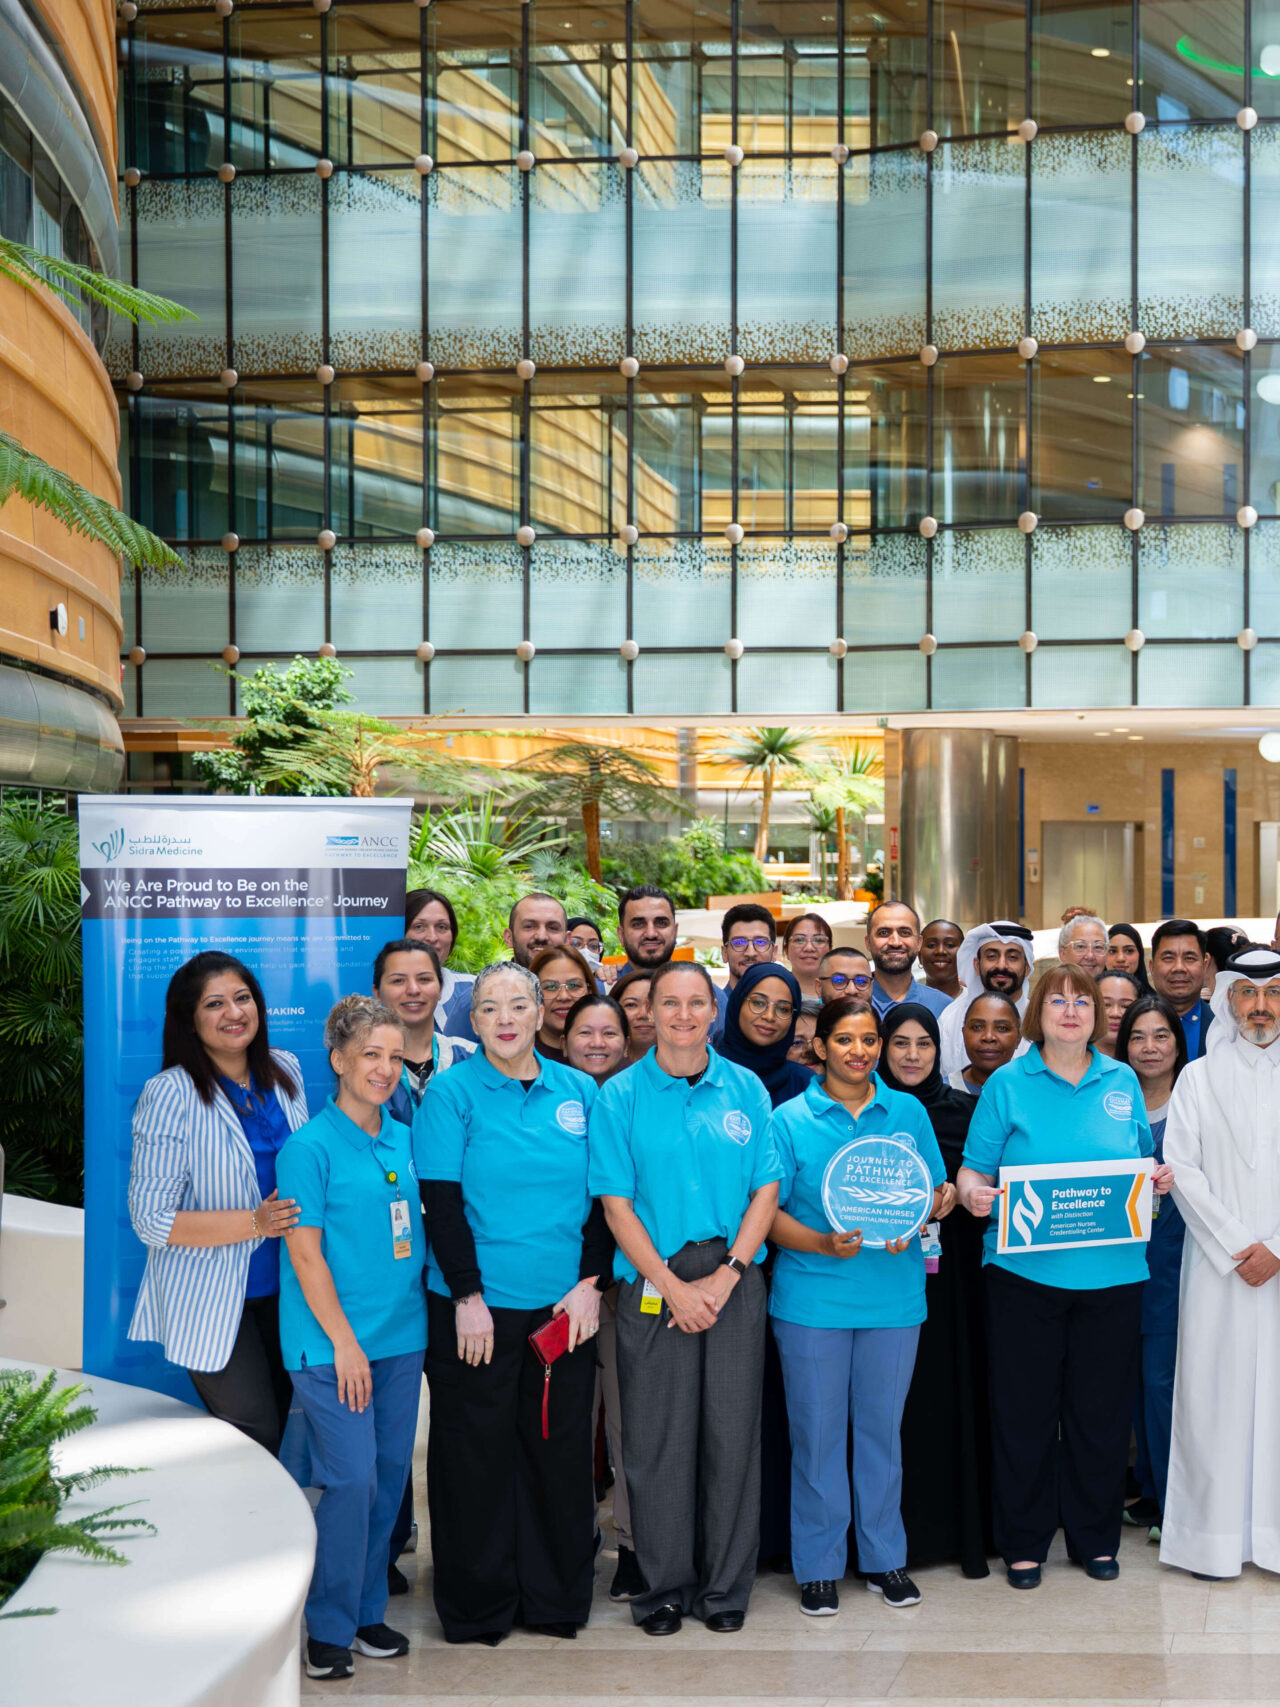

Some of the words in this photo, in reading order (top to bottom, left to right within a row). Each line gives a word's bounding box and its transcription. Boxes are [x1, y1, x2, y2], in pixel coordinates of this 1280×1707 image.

[361, 837, 399, 846] ANCC
[129, 846, 155, 856] Sidra
[157, 846, 203, 856] Medicine
[104, 880, 131, 892] We
[135, 879, 163, 892] Are
[167, 879, 212, 892] Proud
[217, 880, 233, 891] to
[237, 879, 257, 891] Be
[261, 881, 280, 891] on
[284, 879, 308, 891] the
[104, 896, 152, 908] ANCC
[157, 895, 221, 910] Pathway
[226, 896, 241, 908] to
[333, 895, 388, 908] Journey
[168, 936, 199, 944] Pathway
[266, 1007, 305, 1015] MAKING
[847, 1156, 895, 1166] JOURNEY
[900, 1159, 913, 1168] TO
[846, 1164, 913, 1178] PATHWAY
[846, 1174, 857, 1182] TO
[861, 1176, 912, 1186] EXCELLENCE
[1052, 1188, 1099, 1199] Pathway
[1100, 1186, 1112, 1195] to
[1051, 1199, 1105, 1211] Excellence
[841, 1205, 882, 1215] AMERICAN
[884, 1209, 915, 1218] NURSES
[1064, 1211, 1093, 1219] Distinction
[840, 1214, 889, 1224] CREDENTIALING
[1049, 1228, 1086, 1236] Credentialing
